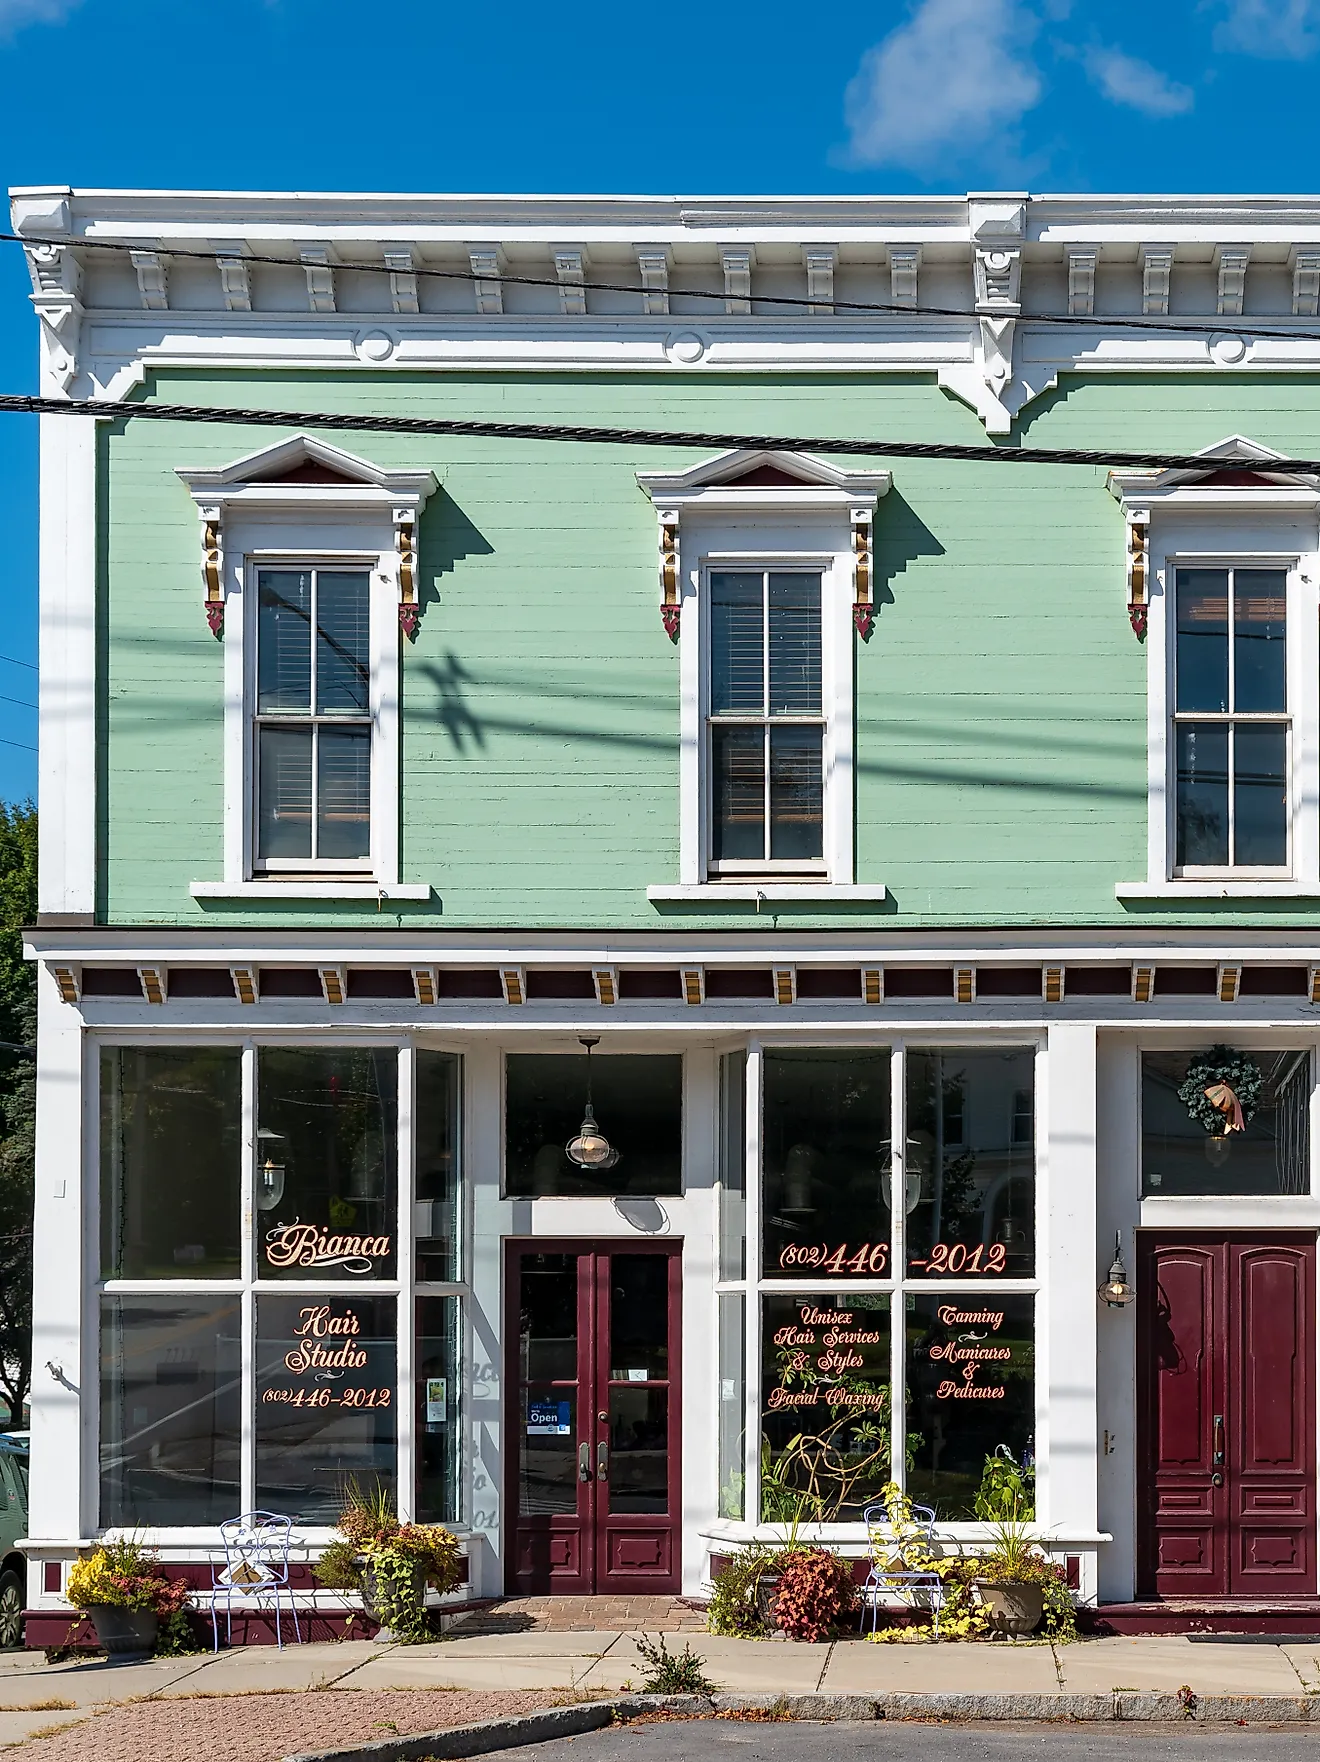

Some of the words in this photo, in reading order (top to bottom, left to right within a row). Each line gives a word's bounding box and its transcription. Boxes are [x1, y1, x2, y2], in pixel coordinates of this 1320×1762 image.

[266, 1224, 390, 1267] Bianca
[293, 1305, 360, 1337] Hair
[801, 1306, 853, 1325] Unisex
[937, 1305, 1004, 1330] Tanning
[773, 1326, 816, 1346] Hair
[822, 1326, 880, 1348] Services
[285, 1338, 367, 1375] Studio
[792, 1351, 810, 1370] &
[817, 1349, 864, 1375] Styles
[929, 1341, 1011, 1363] Manicures
[962, 1361, 981, 1380] &
[262, 1387, 392, 1408] (802)446-2012
[936, 1380, 1005, 1399] Pedicures
[530, 1413, 558, 1424] Open
